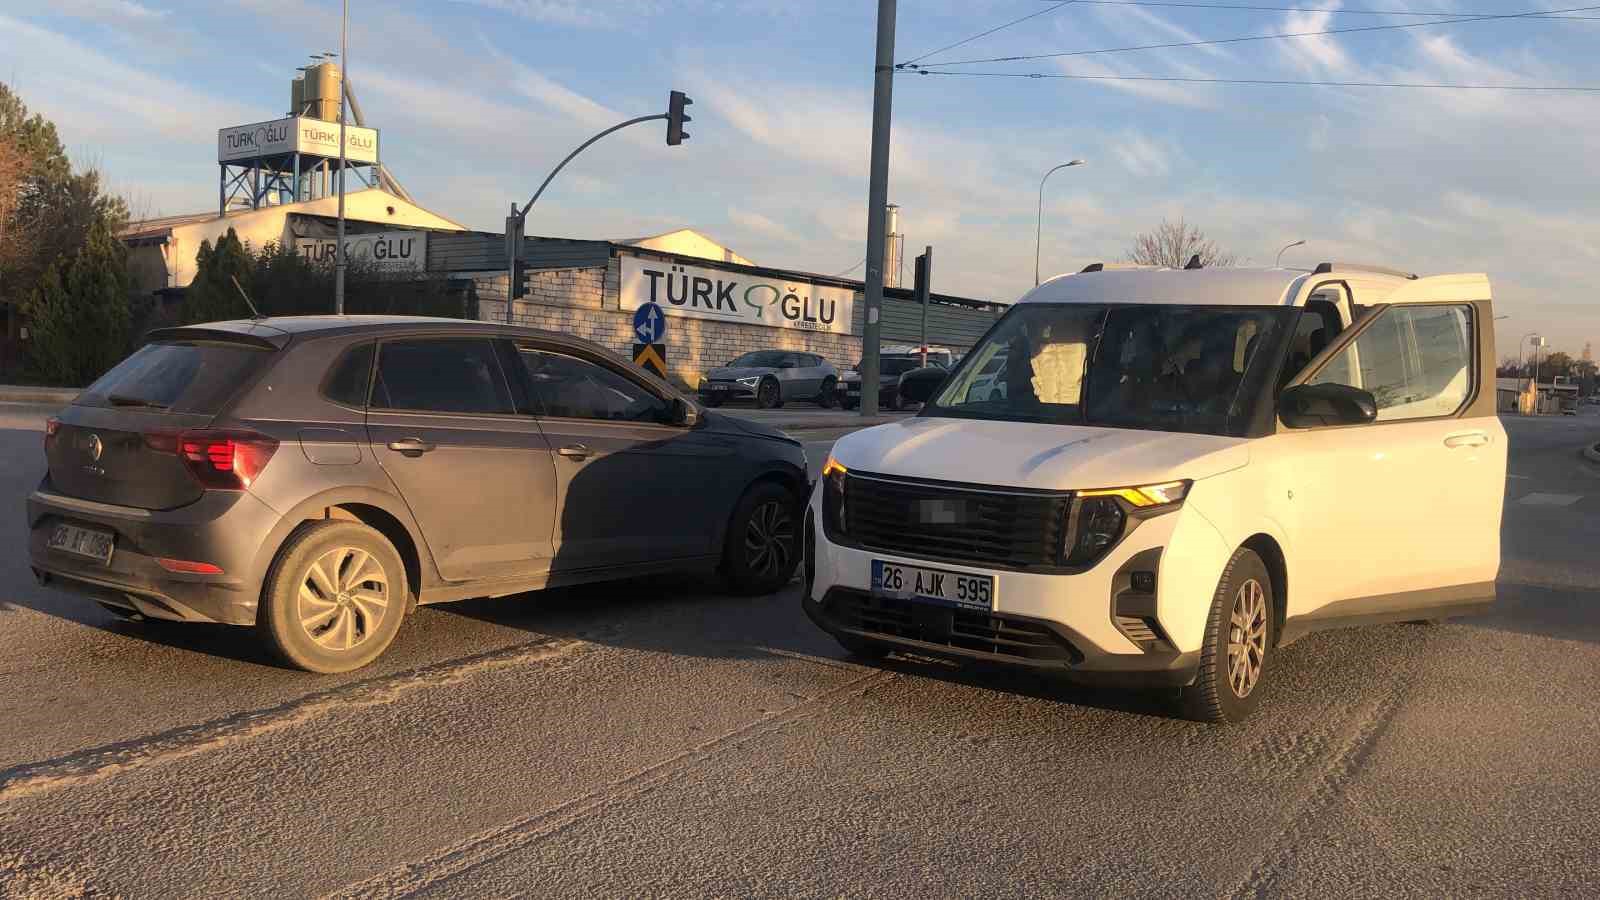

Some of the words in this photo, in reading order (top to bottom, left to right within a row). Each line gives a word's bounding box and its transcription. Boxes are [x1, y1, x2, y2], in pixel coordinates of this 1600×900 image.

[883, 567, 903, 590] 26
[914, 571, 945, 597] AJK
[957, 577, 990, 602] 595
